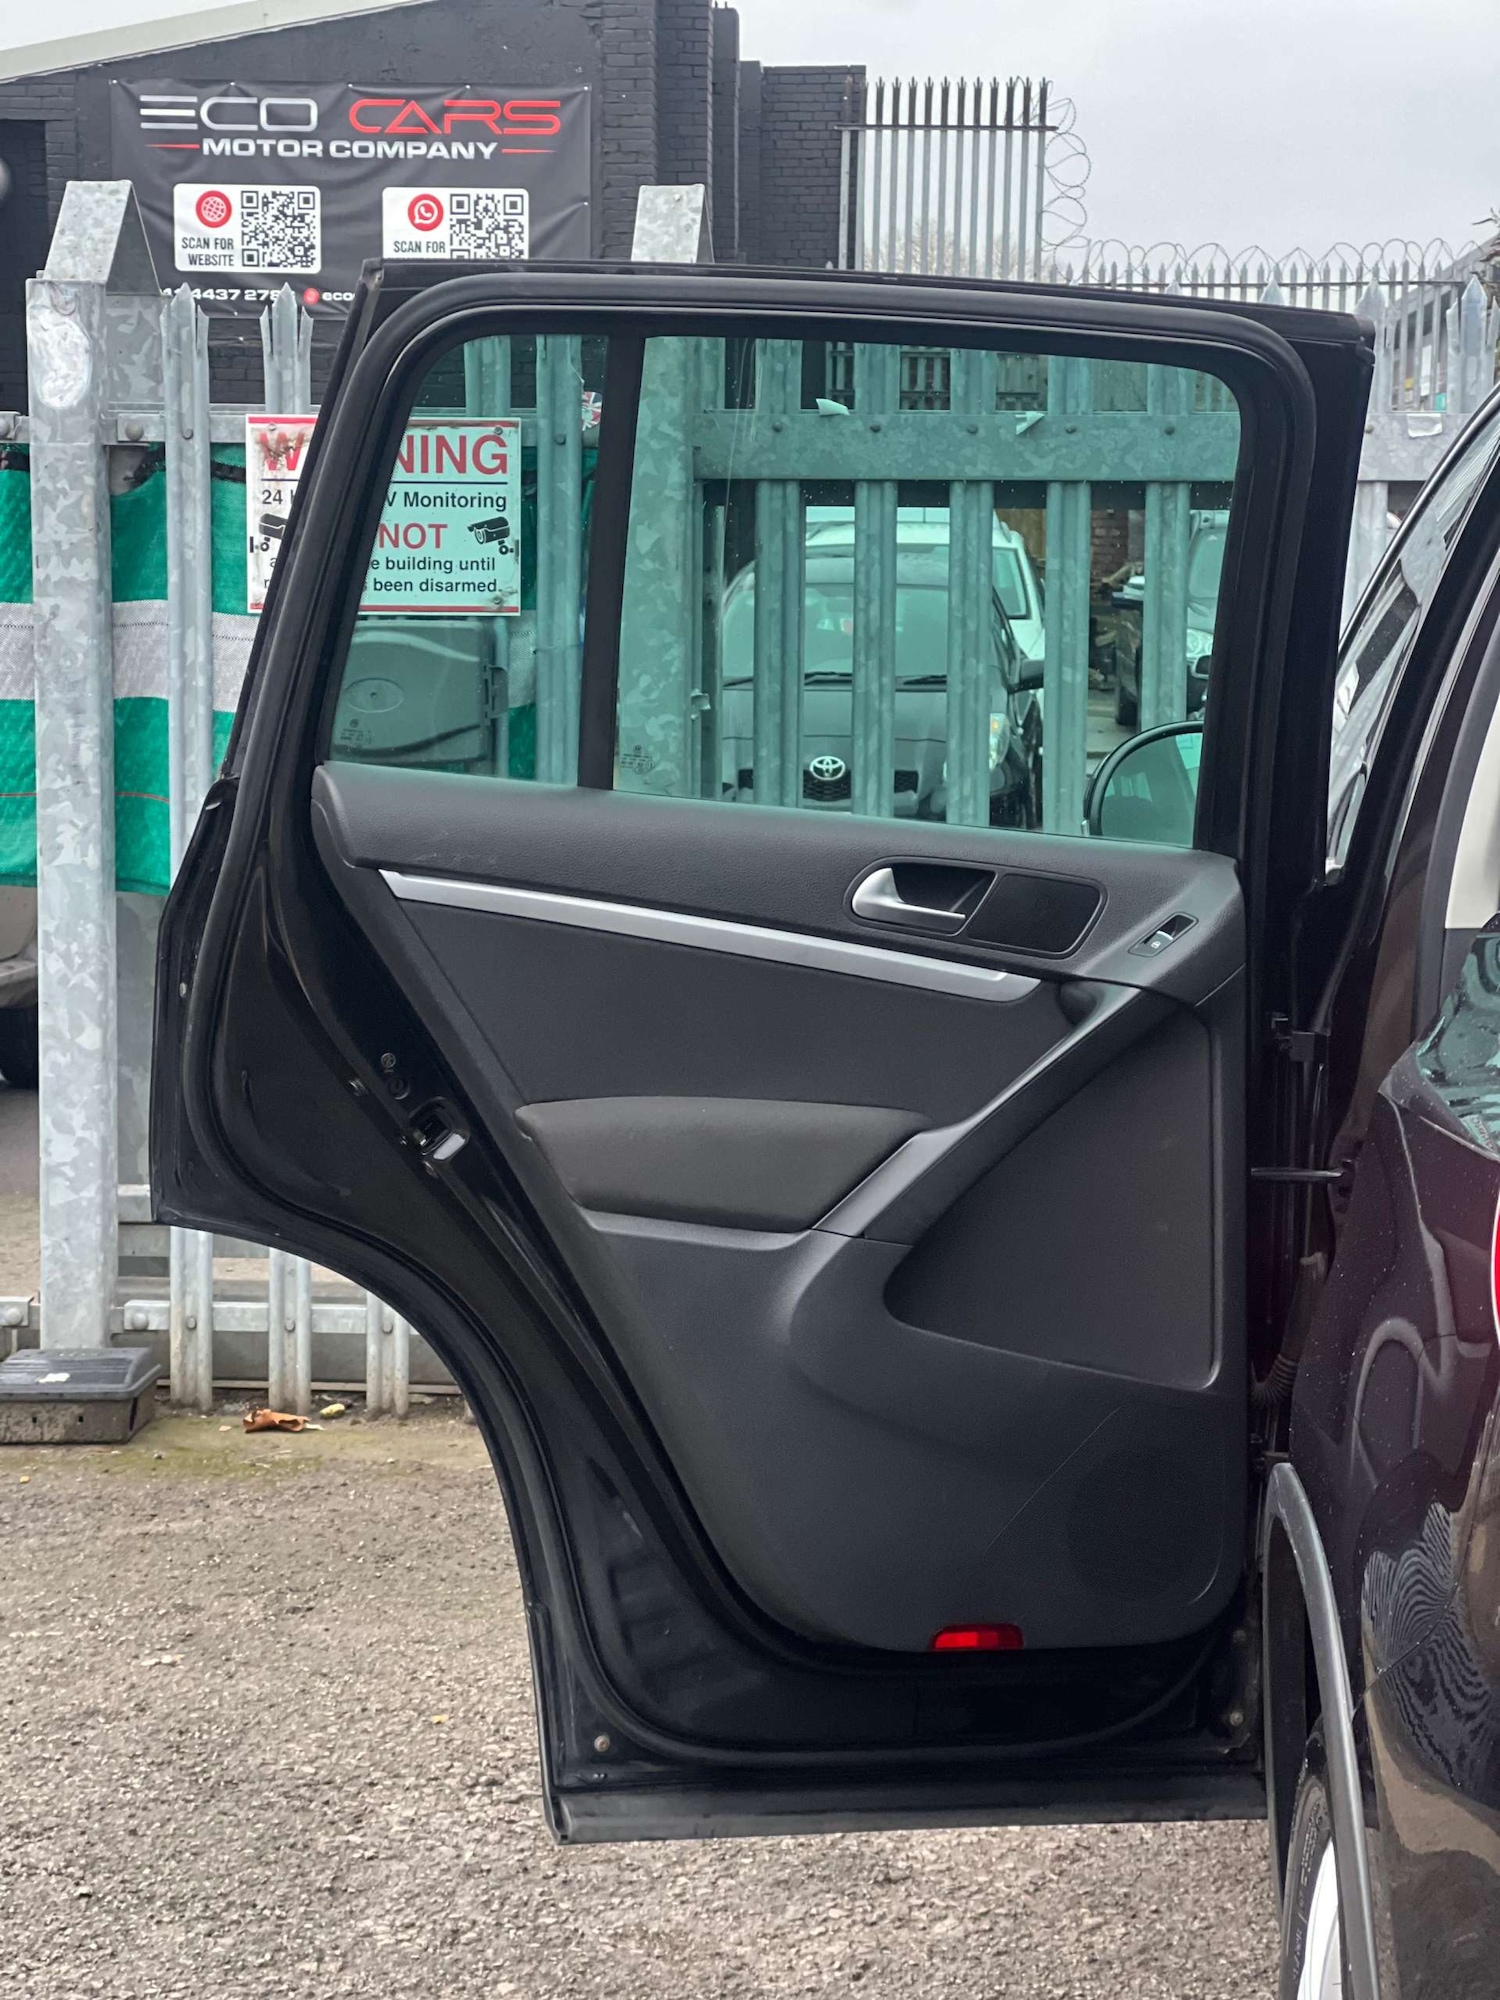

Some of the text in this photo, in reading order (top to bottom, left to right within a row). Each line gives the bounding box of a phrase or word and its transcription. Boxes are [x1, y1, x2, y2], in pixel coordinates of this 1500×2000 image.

[140, 95, 561, 136] ECO CARS
[202, 138, 498, 160] MOTOR COMPANY
[182, 237, 234, 251] SCAN FOR
[393, 240, 446, 254] SCAN FOR
[187, 253, 235, 267] WEBSITE
[261, 489, 283, 505] 24
[403, 491, 507, 512] Monitoring
[379, 522, 448, 549] NOT
[385, 557, 453, 574] building
[459, 557, 496, 571] until
[373, 578, 413, 592] been
